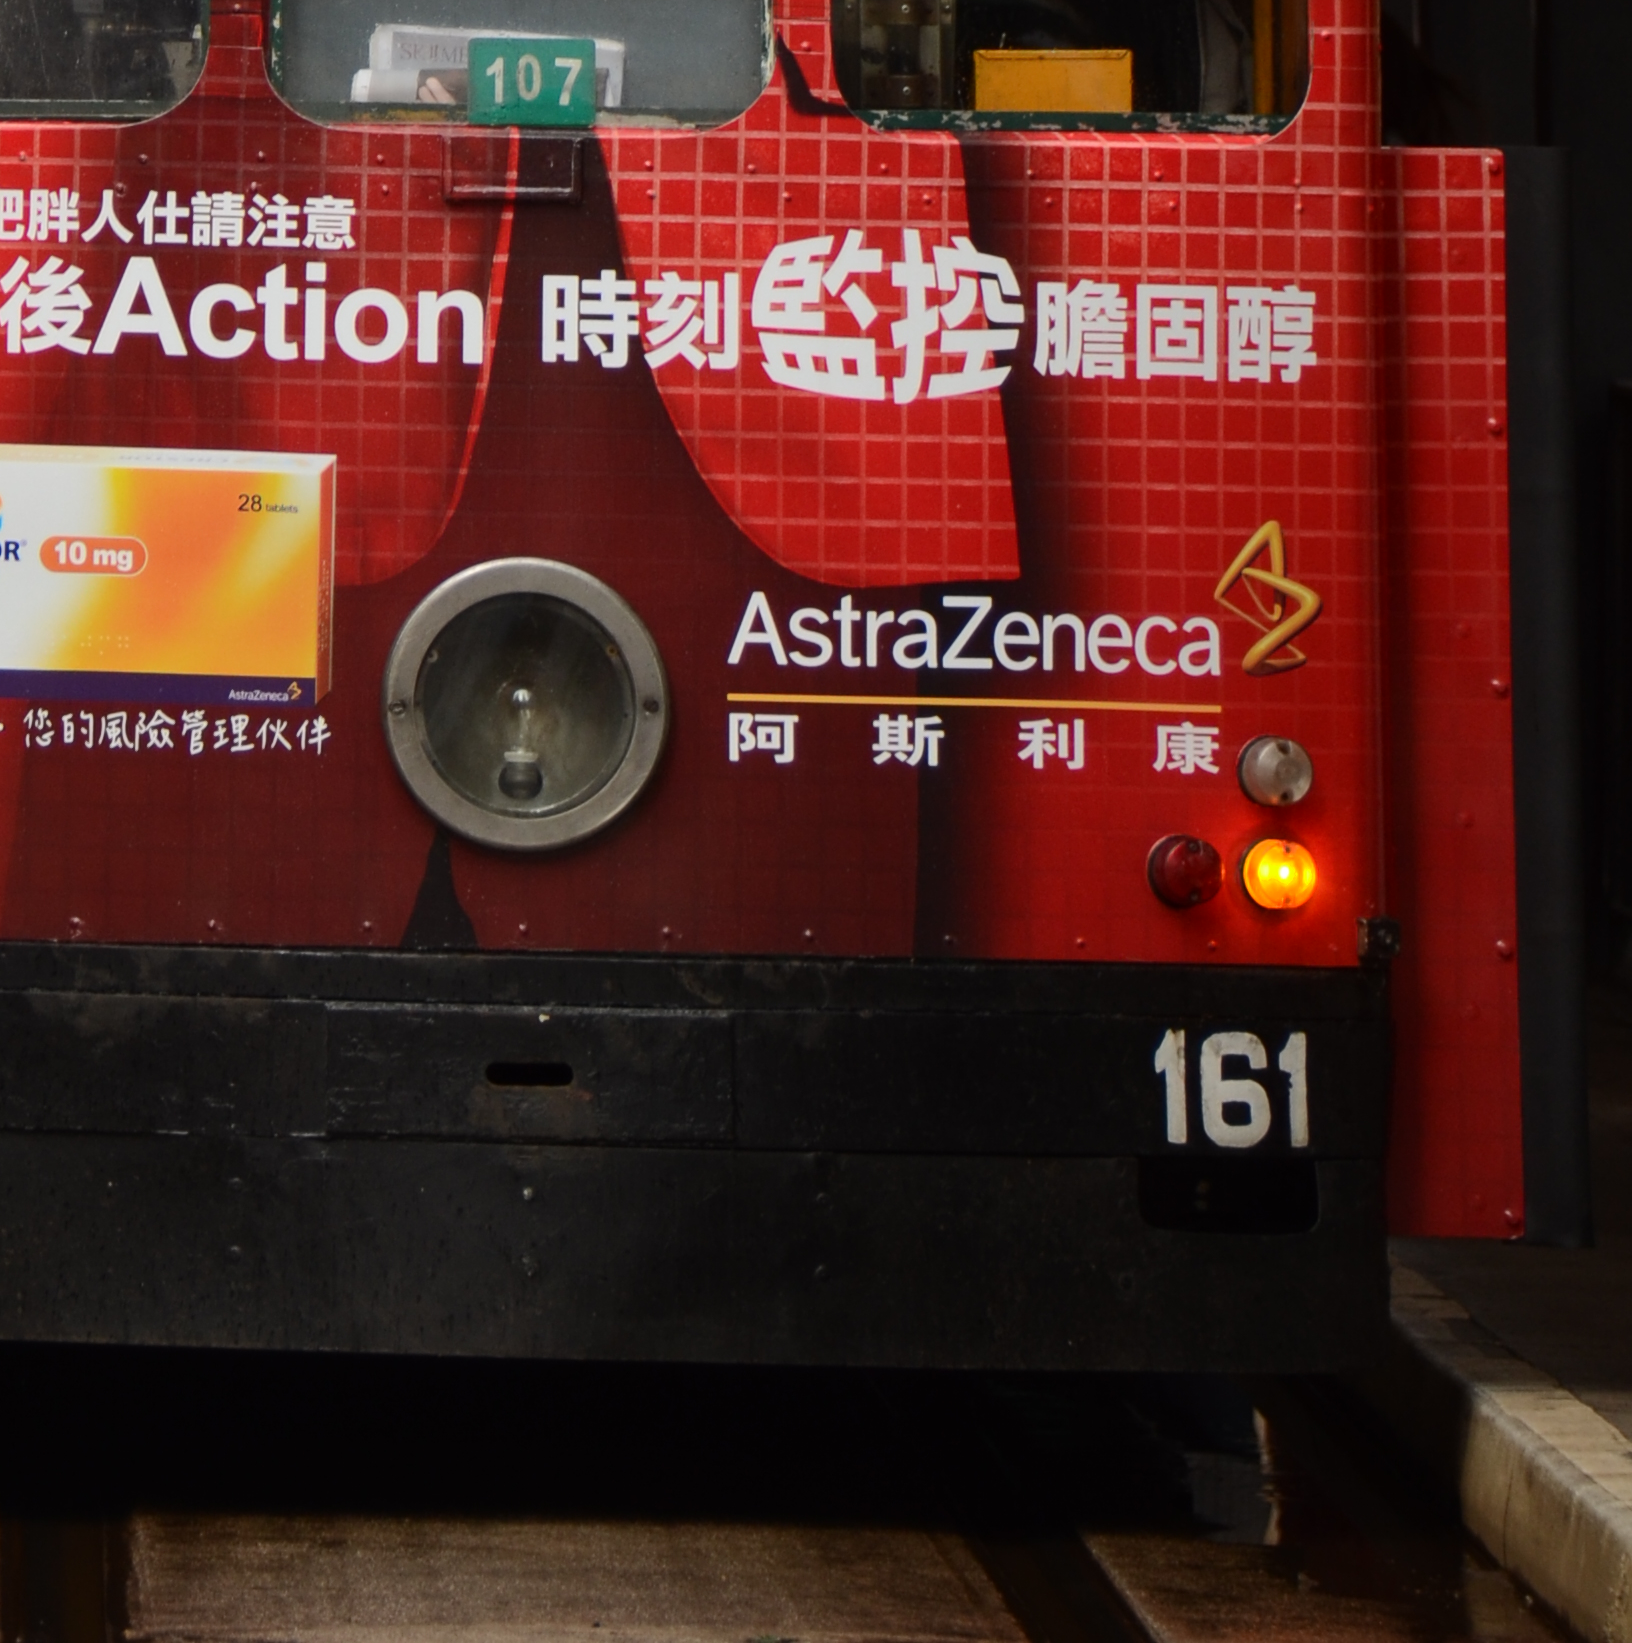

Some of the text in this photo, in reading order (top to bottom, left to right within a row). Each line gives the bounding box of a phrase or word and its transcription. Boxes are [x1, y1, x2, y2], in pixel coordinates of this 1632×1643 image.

[485, 53, 583, 107] 107
[541, 228, 1318, 405] 時刻監控膽固醇
[237, 493, 299, 515] 28 tablets
[54, 540, 134, 572] 10 mg
[726, 591, 1222, 677] AstraZeneca
[228, 687, 289, 703] AstraZeneca
[727, 711, 1222, 775] 阿斯利康
[1154, 1028, 1310, 1149] 161
